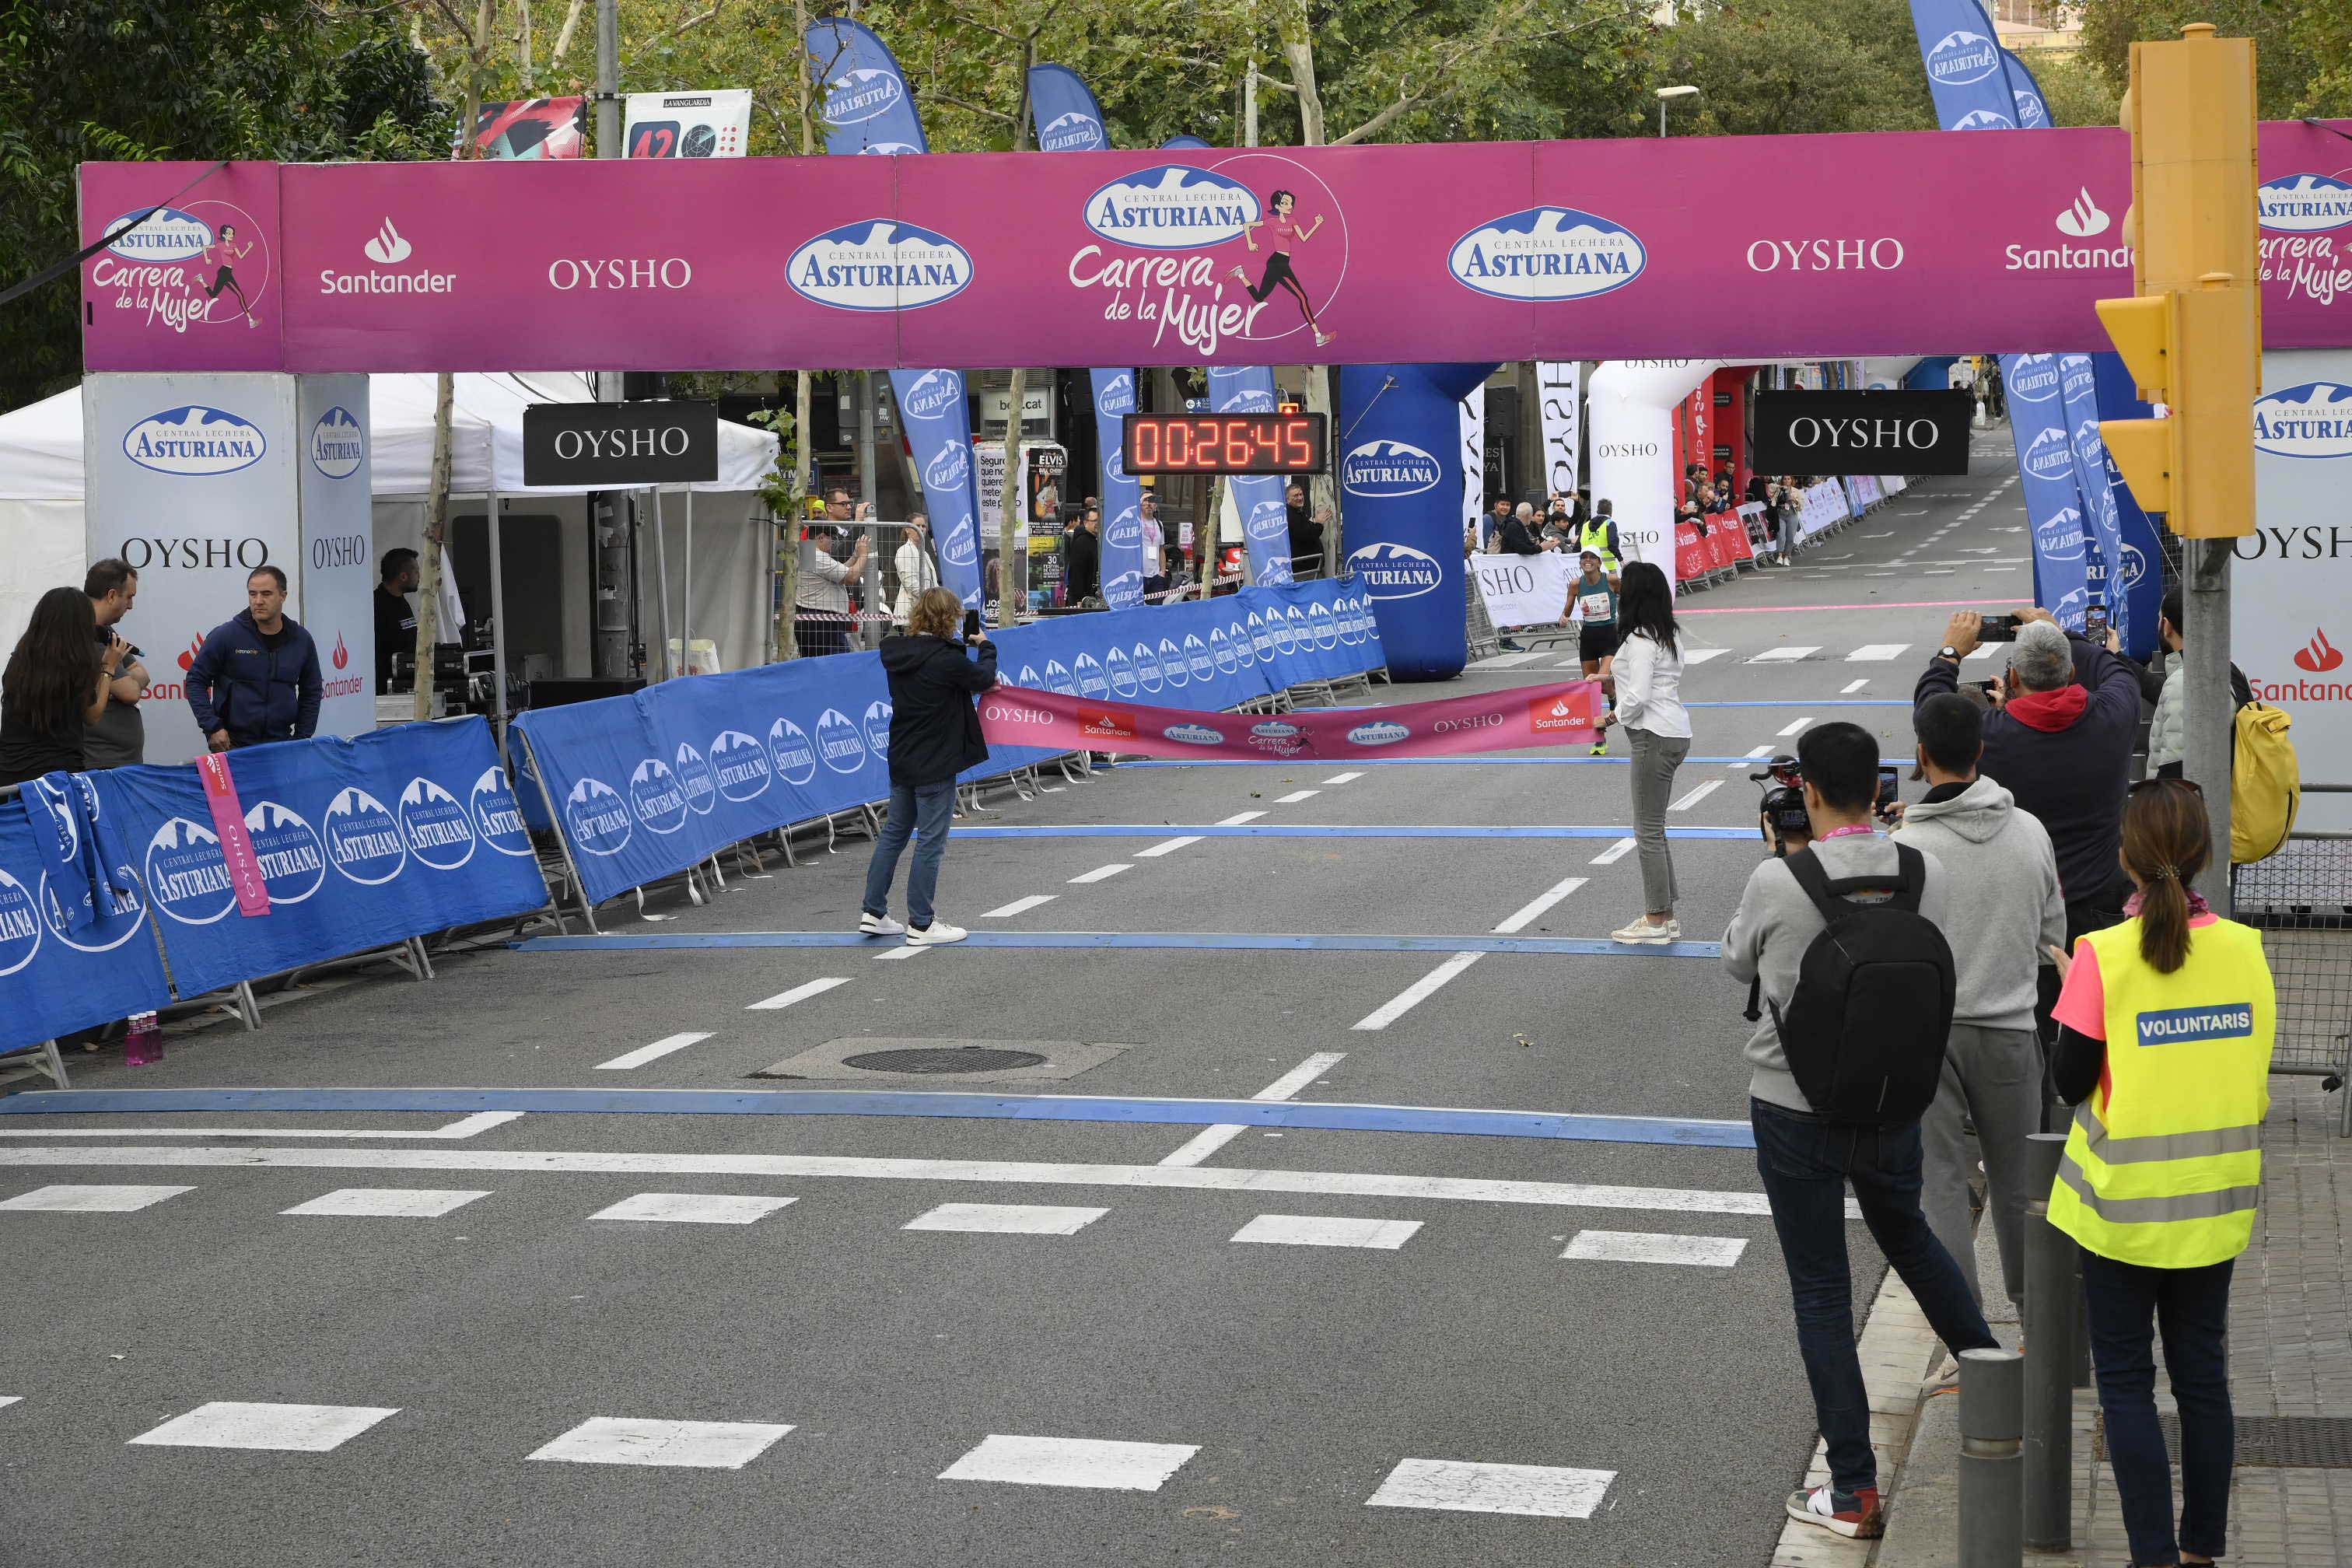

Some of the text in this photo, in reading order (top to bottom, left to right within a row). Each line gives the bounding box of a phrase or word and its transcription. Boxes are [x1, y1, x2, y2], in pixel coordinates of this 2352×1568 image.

[1125, 193, 1242, 202] CENTRAL LECHERA
[1097, 197, 1246, 228] ASTURIANA
[829, 250, 953, 261] CENTRAL LECHERA
[1494, 238, 1625, 250] CENTRAL LECHERA
[1747, 237, 1905, 272] OYSHO
[2259, 236, 2333, 258] arrera
[1069, 244, 1213, 288] Carrera
[1463, 243, 1631, 278] ASTURIANA
[2005, 244, 2135, 271] Santand
[93, 258, 184, 288] Carrera
[320, 269, 457, 295] Santander
[548, 257, 691, 290] OYSHO
[800, 254, 959, 289] ASTURIANA
[2277, 260, 2291, 281] la
[2287, 254, 2352, 305] Muje
[115, 285, 219, 333] de la Mujer
[1104, 283, 1269, 355] de la Mujer
[2254, 411, 2352, 439] ASTURIA
[2275, 408, 2327, 418] CENTRAL
[134, 432, 256, 458] ASTURIANA
[555, 427, 689, 460] OYSHO
[1136, 422, 1310, 465] 00:26:45
[1789, 417, 1939, 450] OYSHO
[315, 434, 361, 461] ASTURIANA
[1039, 455, 1063, 465] ELVIS
[1486, 447, 1500, 457] ES
[1598, 443, 1657, 458] OYSHO
[981, 468, 994, 478] que
[981, 477, 1006, 487] quiere
[1346, 463, 1433, 485] ASTURIANA
[982, 488, 1001, 497] mete
[1622, 530, 1659, 544] SHO
[2232, 526, 2352, 561] OYSH
[121, 537, 268, 570] OYSHO
[313, 534, 365, 570] OYSHO
[1048, 556, 1057, 565] 30
[1363, 569, 1434, 586] TURIANA
[1482, 565, 1535, 596] SHO
[2250, 677, 2352, 702] Santan
[985, 706, 1054, 725] OYSHO
[1434, 712, 1504, 733] OYSHO
[1536, 716, 1586, 729] Santander
[1084, 725, 1131, 737] Santander
[1168, 730, 1220, 742] ASTURIANA
[1248, 735, 1289, 745] Carrera
[1352, 730, 1406, 742] ASTURIANA
[821, 736, 863, 759] ASTURIANA
[1273, 744, 1302, 757] Mujer
[714, 758, 768, 788] ASTURIANA
[405, 814, 471, 849] ASTURIANA
[478, 803, 524, 837] ASTUR
[282, 831, 310, 845] LECHERA
[332, 826, 402, 863] ASTURIANA
[163, 849, 223, 868] CENTRAL LECHERA
[228, 824, 256, 898] OYSHO
[257, 845, 321, 880] STURIANA
[156, 862, 233, 903] ASTURIANA
[2140, 1011, 2250, 1038] VOLUNTARIS
